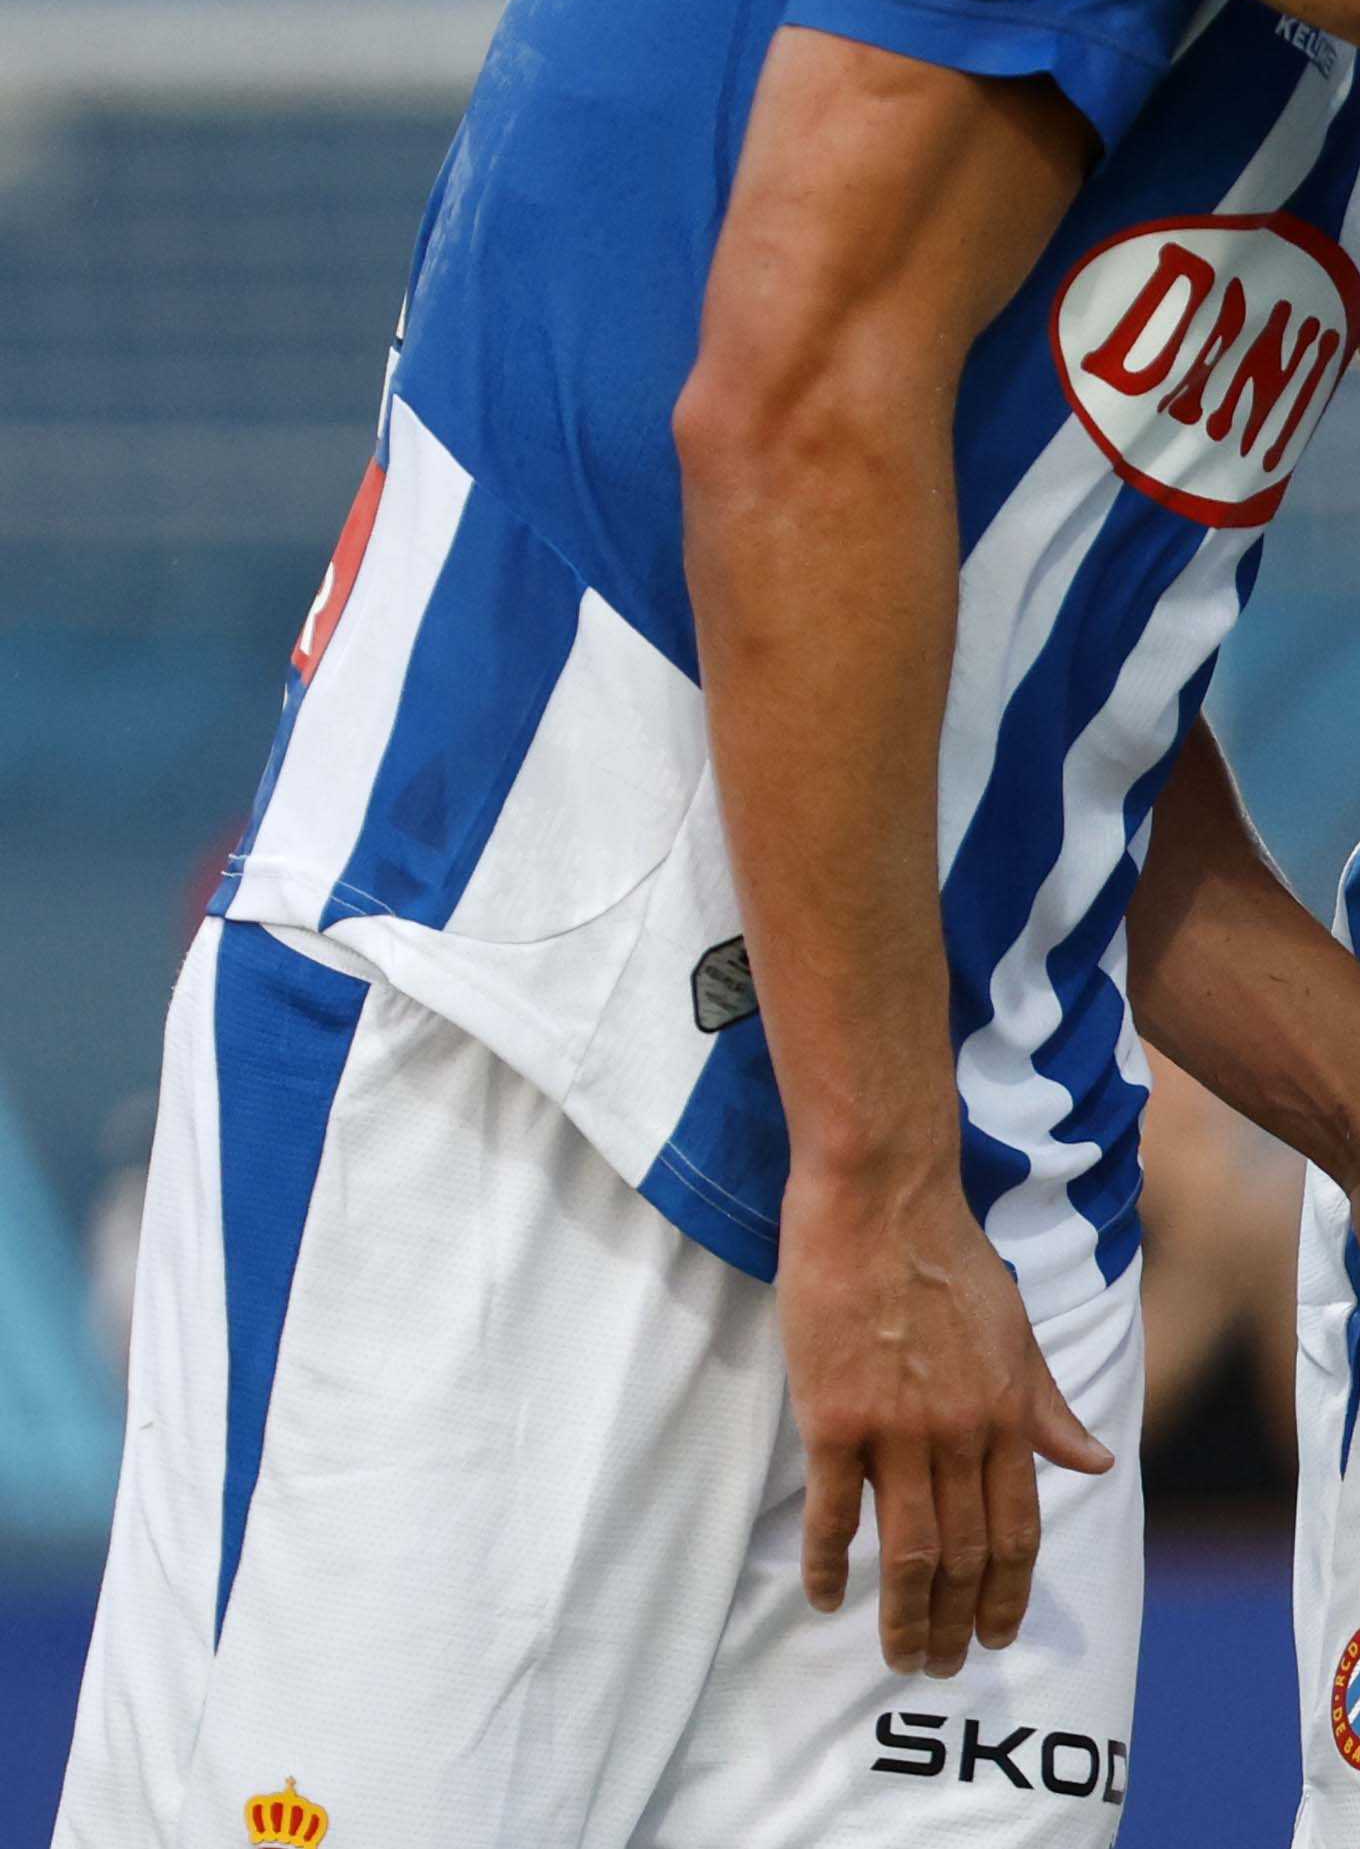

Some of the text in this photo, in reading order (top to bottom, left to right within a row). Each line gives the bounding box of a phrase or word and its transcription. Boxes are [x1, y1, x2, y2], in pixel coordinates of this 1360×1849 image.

[1081, 242, 1340, 472] DANI
[1335, 1642, 1358, 1687] RCD
[1333, 1707, 1346, 1737] DE
